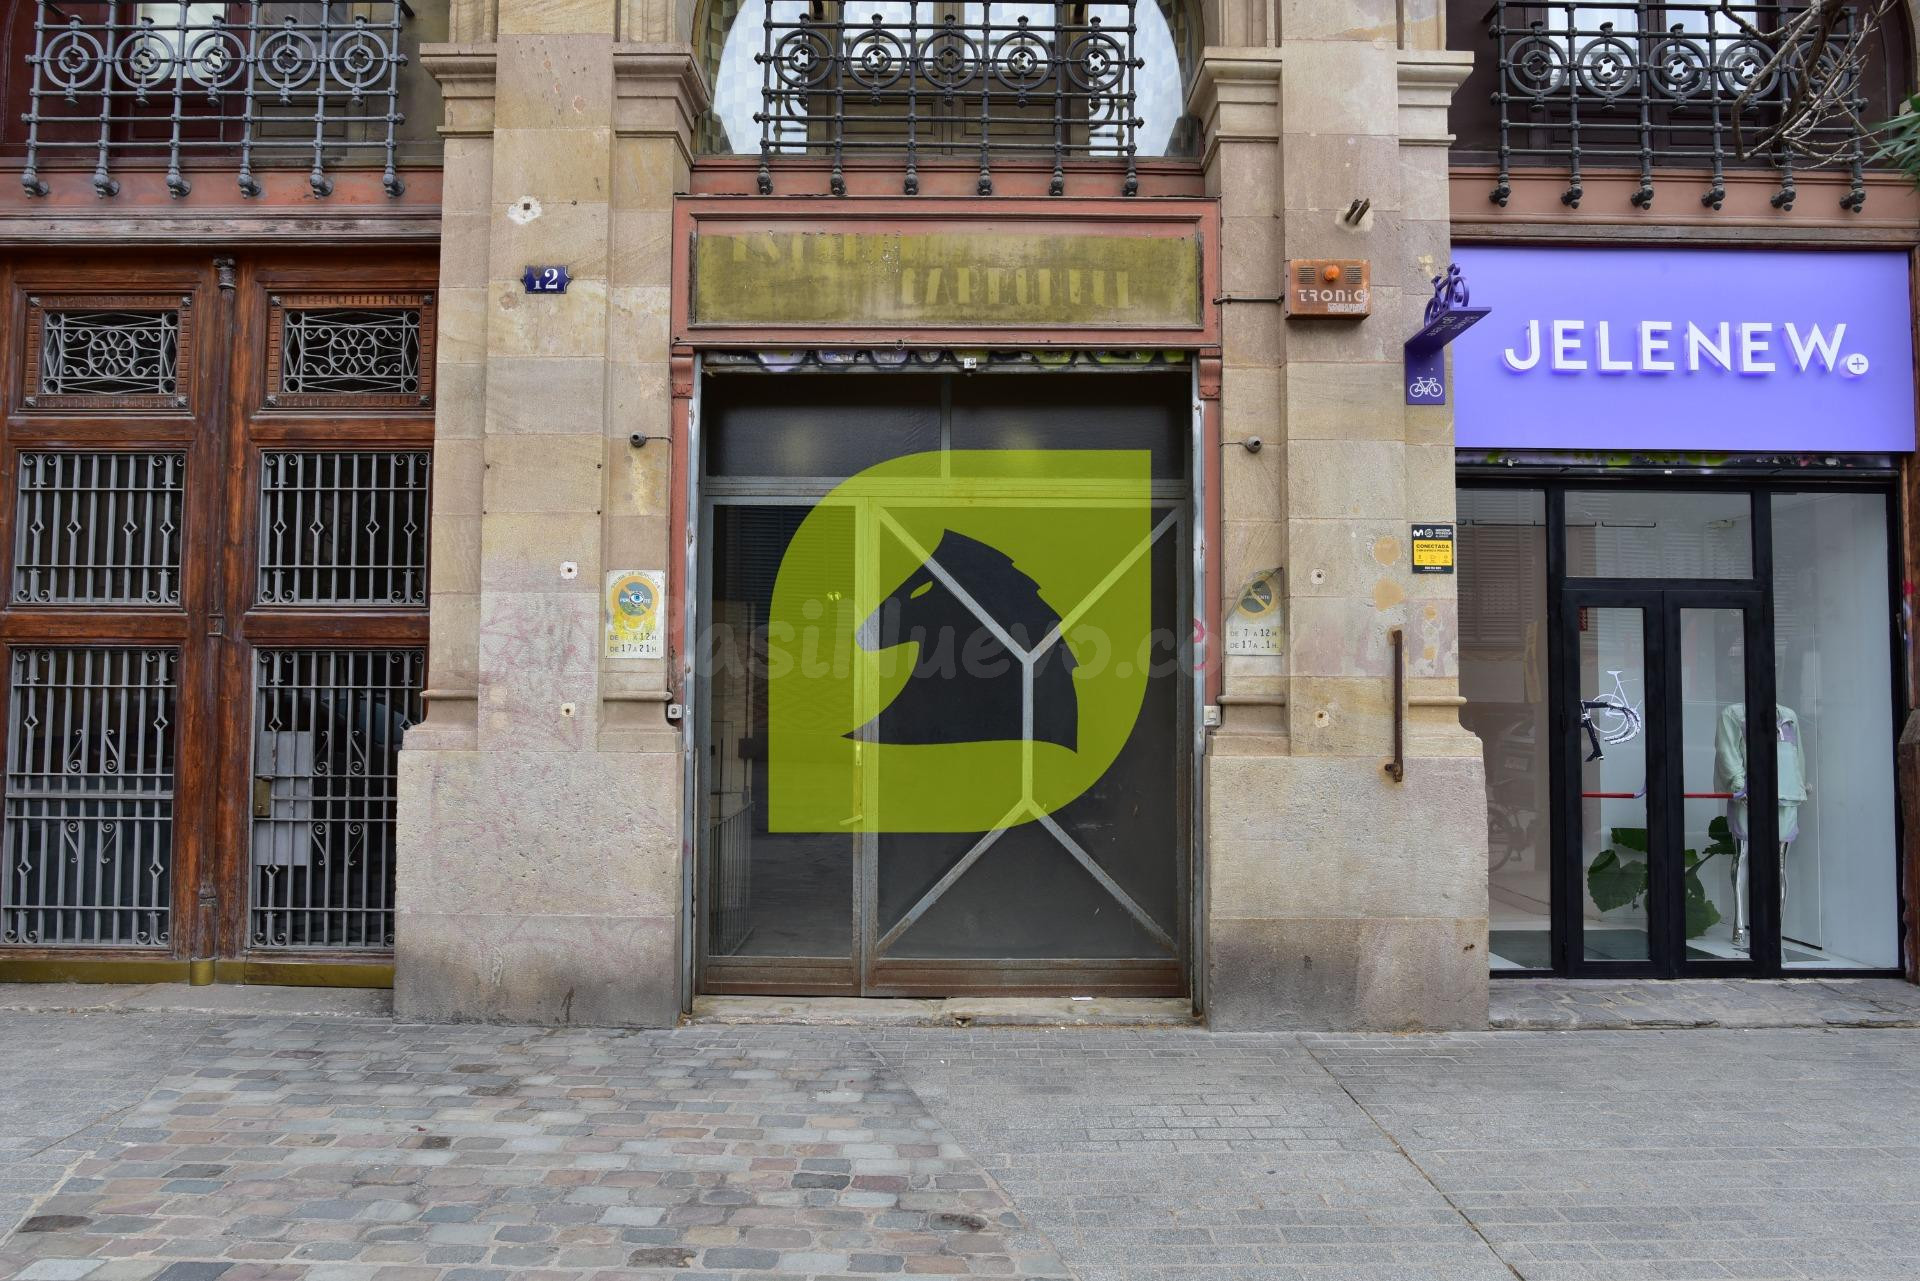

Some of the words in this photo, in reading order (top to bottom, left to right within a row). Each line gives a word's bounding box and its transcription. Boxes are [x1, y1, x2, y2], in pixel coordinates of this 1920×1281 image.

[640, 632, 650, 641] 12
[1260, 628, 1270, 637] 12
[621, 643, 632, 652] 17
[639, 644, 650, 653] 21
